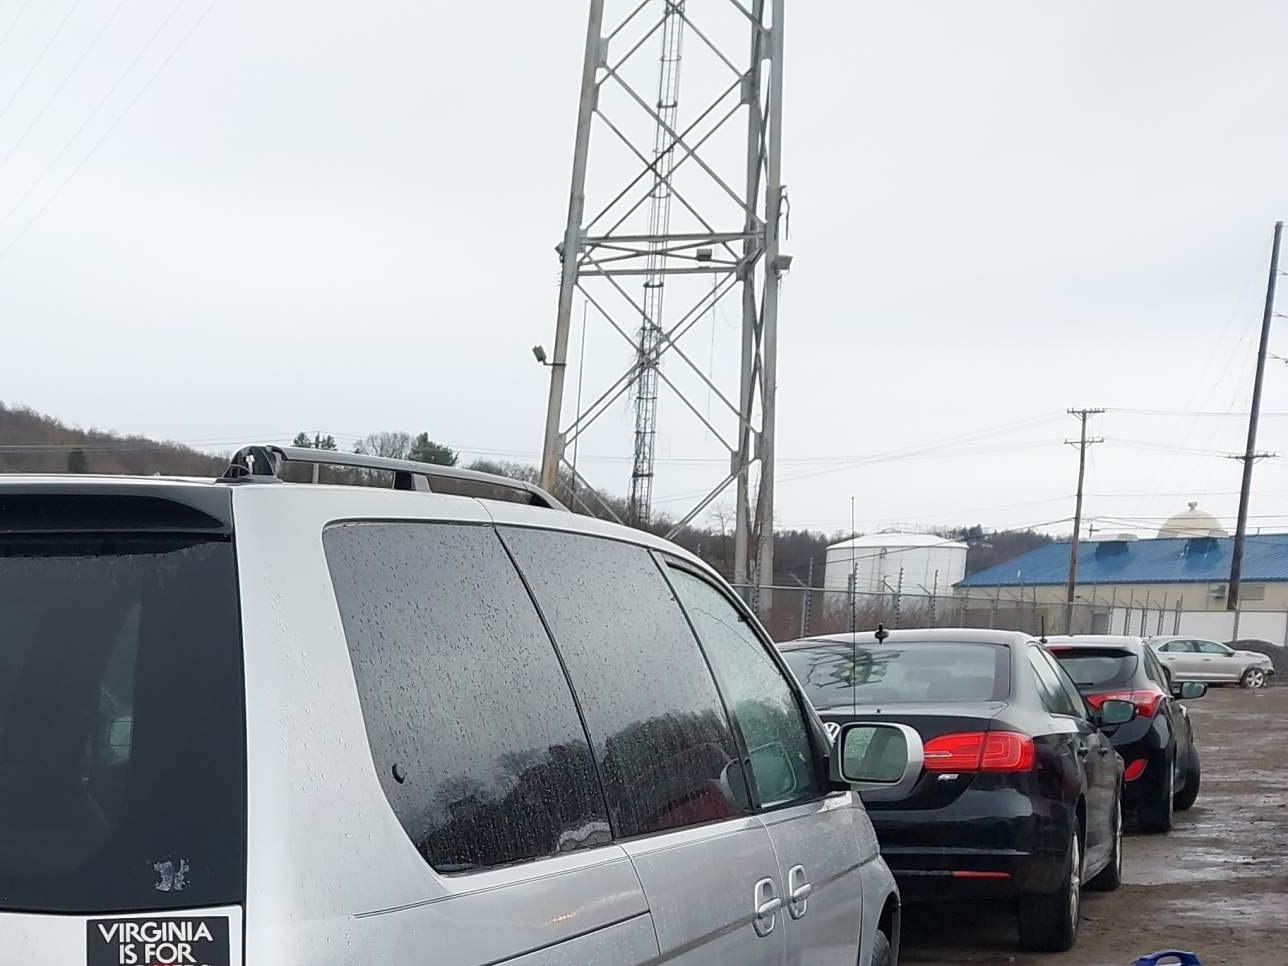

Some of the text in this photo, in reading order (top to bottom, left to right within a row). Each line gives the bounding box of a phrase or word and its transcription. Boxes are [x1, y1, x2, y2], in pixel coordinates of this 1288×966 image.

[97, 920, 213, 943] VIRGINIA
[119, 942, 197, 965] IS FOR
